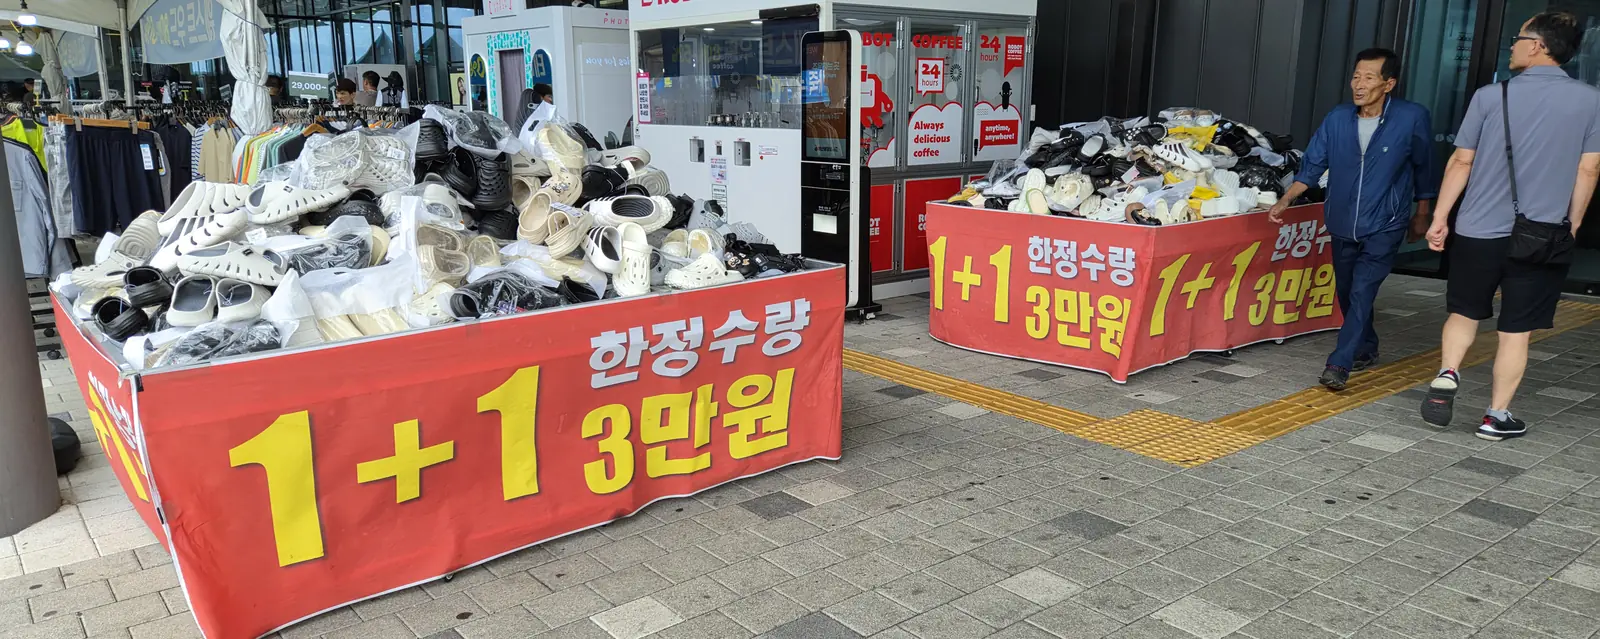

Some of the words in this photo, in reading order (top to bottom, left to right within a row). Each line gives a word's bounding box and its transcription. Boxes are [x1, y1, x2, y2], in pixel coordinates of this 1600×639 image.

[912, 33, 963, 50] COFFEE
[980, 34, 1001, 53] 24
[980, 52, 999, 61] hours
[921, 63, 941, 79] 24
[921, 78, 939, 87] hours
[913, 120, 945, 132] Always
[985, 124, 1011, 133] anytime,
[913, 134, 951, 144] delicious
[984, 133, 1015, 142] anywhere!
[913, 147, 940, 158] coffee
[1027, 235, 1136, 288] 한정수량
[1248, 263, 1337, 327] 3만원
[1025, 285, 1132, 360] 3만원
[588, 297, 811, 390] 한정수량
[580, 366, 797, 496] 3만원
